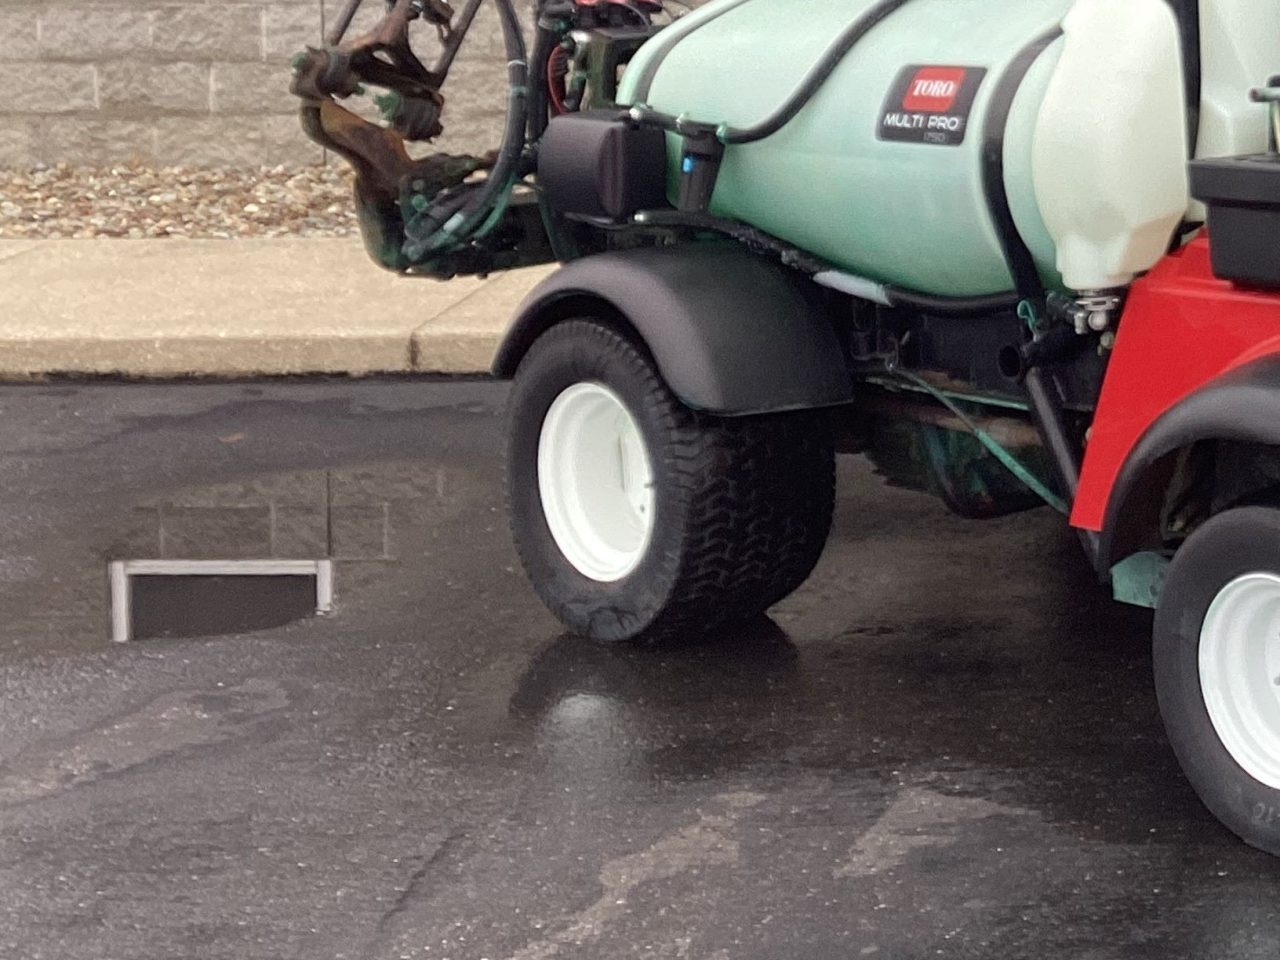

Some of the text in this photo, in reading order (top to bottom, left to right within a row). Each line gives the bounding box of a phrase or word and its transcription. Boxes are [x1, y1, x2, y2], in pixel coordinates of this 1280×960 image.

[912, 79, 954, 97] TORO
[883, 113, 959, 131] MULTI PRO
